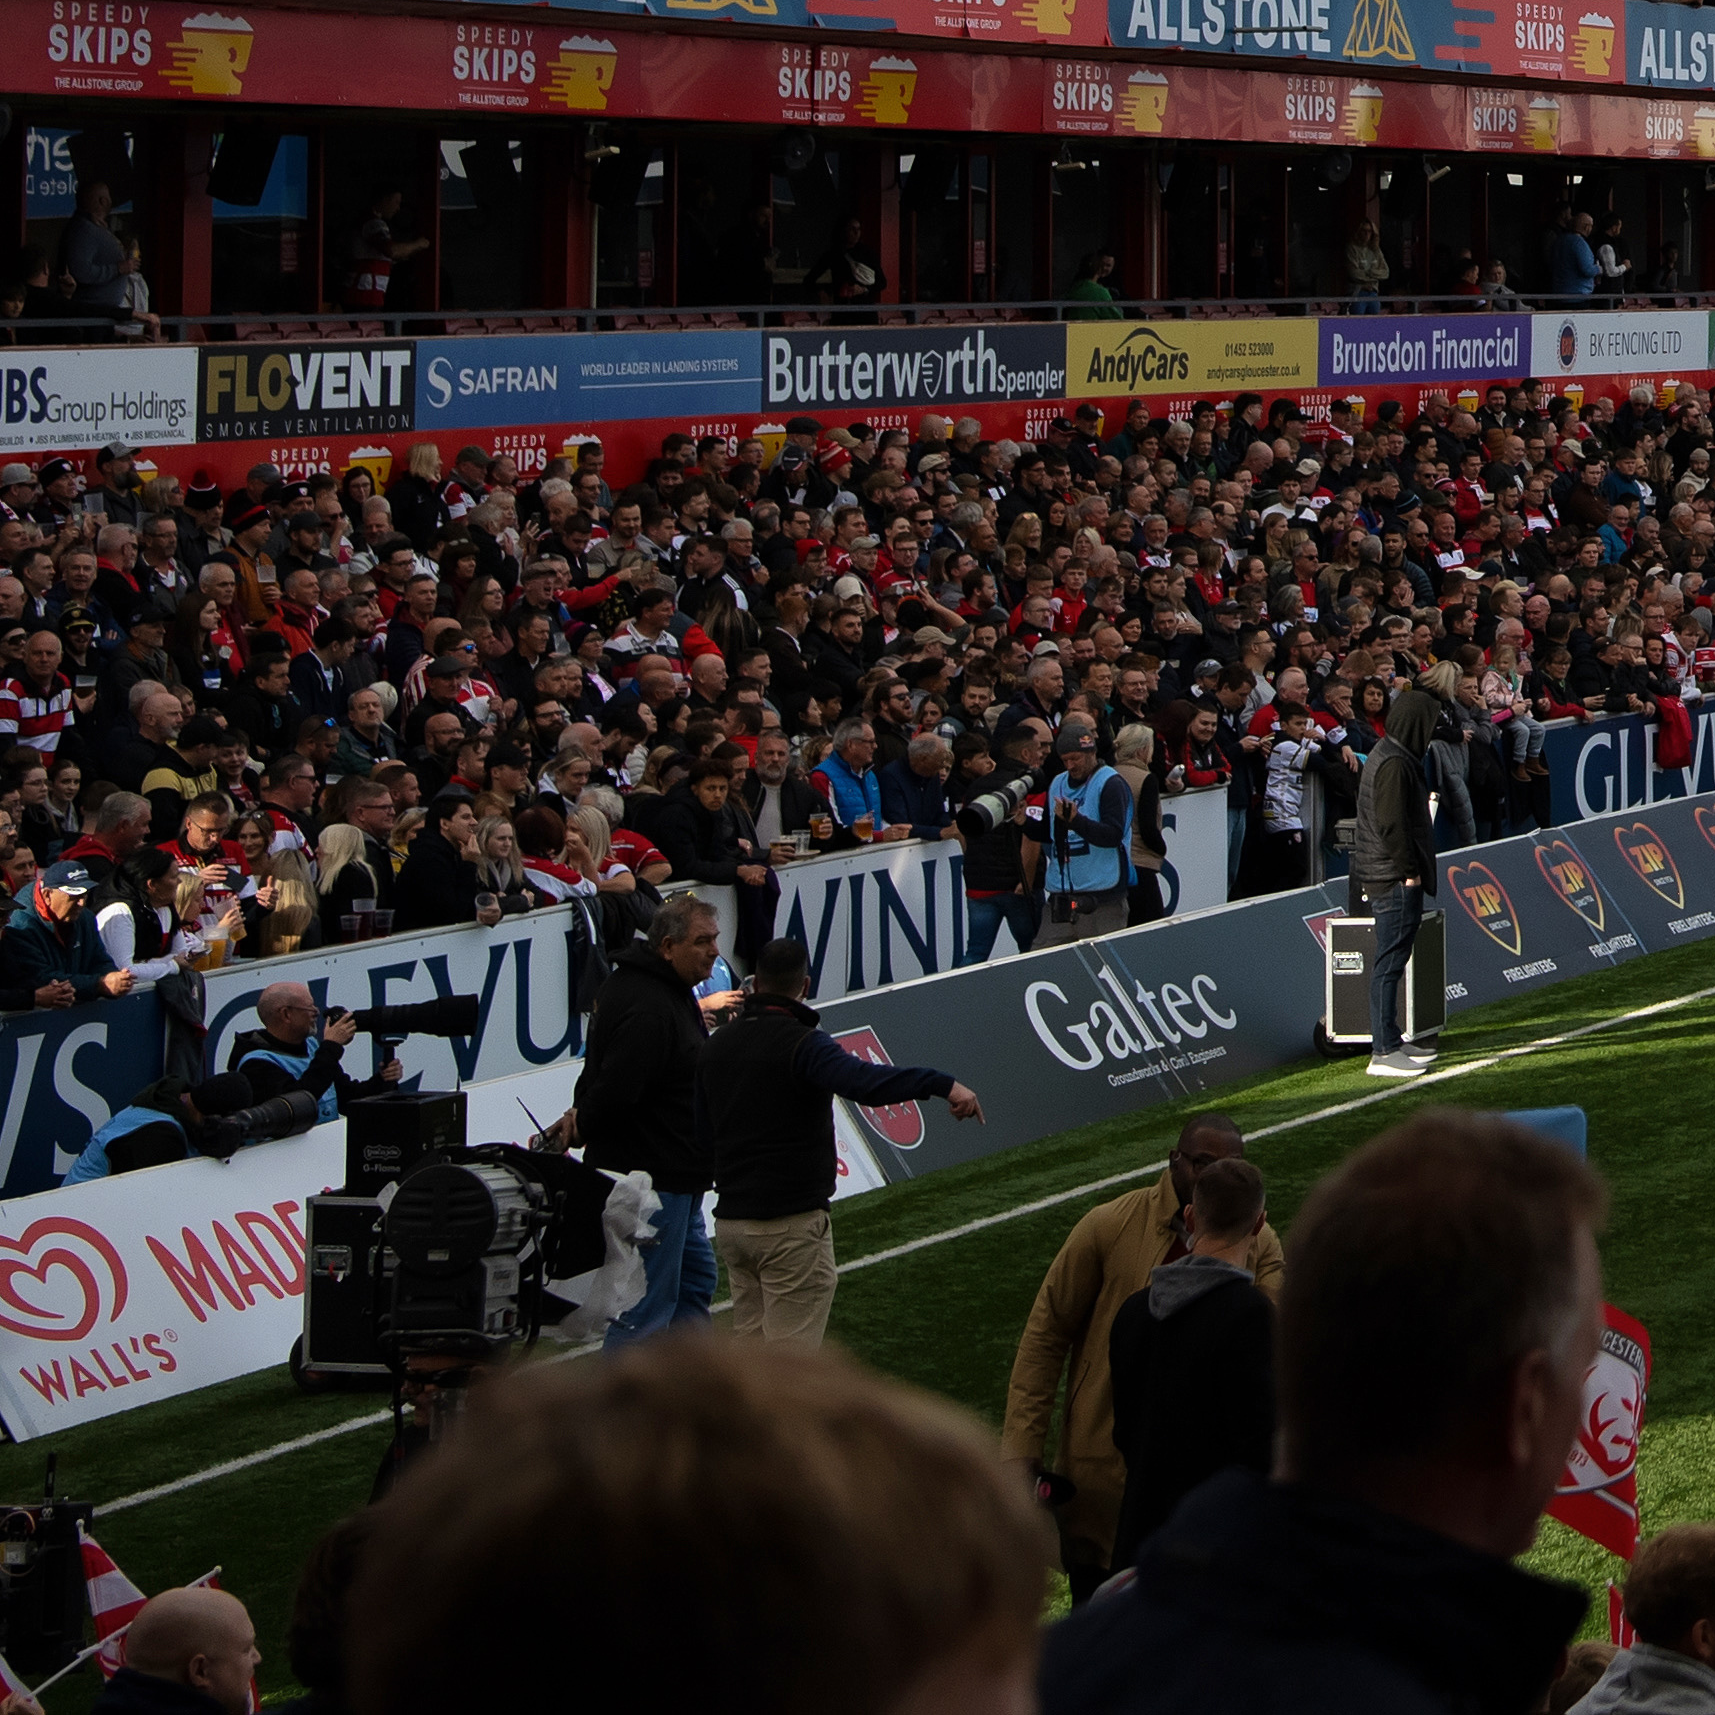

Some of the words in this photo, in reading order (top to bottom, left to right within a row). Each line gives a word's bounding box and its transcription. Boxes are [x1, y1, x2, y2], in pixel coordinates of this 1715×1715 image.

[53, 1, 150, 25] SPEEDY
[1516, 1, 1564, 22] SPEEDY
[48, 25, 152, 66] SKIPS
[457, 25, 534, 47] SPEEDY
[1515, 19, 1565, 53] SKIPS
[453, 44, 536, 84] SKIPS
[782, 47, 849, 68] SPEEDY
[778, 66, 851, 101] SKIPS
[1056, 64, 1111, 82] SPEEDY
[1287, 77, 1334, 94] SPEEDY
[1053, 81, 1113, 113] SKIPS
[1285, 94, 1336, 123] SKIPS
[1473, 106, 1517, 133] SKIPS
[1646, 117, 1684, 141] SKIPS
[1224, 342, 1246, 357] 01452
[1247, 341, 1275, 357] 523000
[1332, 331, 1426, 377] Brunsdon
[1432, 327, 1519, 371] Financial
[1589, 334, 1605, 358] BK
[1608, 332, 1657, 358] FENCING
[1659, 330, 1682, 355] LTD
[458, 364, 558, 396] SAFRAN
[580, 362, 614, 376] WORLD
[615, 361, 648, 375] LEADER
[650, 360, 660, 373] IN
[662, 358, 699, 374] LANDING
[700, 357, 739, 372] SYSTEMS
[206, 349, 412, 415] FLOVENT
[997, 363, 1065, 400] Spengler
[46, 393, 106, 430] Group
[110, 390, 187, 428] Holdings
[205, 420, 270, 439] SMOKE
[284, 411, 413, 435] VENTILATION
[691, 423, 738, 438] SPEEDY
[271, 448, 330, 463] SPEEDY
[495, 433, 546, 450] SPEEDY
[1629, 842, 1665, 874] ZIP
[1551, 861, 1584, 895] ZIP
[1464, 884, 1502, 917] ZIP
[1589, 933, 1637, 958] FIRELIGHTERS
[1503, 958, 1557, 983] FIRELIGHTERS
[1025, 964, 1238, 1070] Galtec
[1108, 1065, 1162, 1087] Groundworks
[1160, 1059, 1170, 1072] &
[1171, 1054, 1188, 1071] Civil
[1189, 1045, 1228, 1066] Engineers
[19, 1332, 178, 1406] WALL'S
